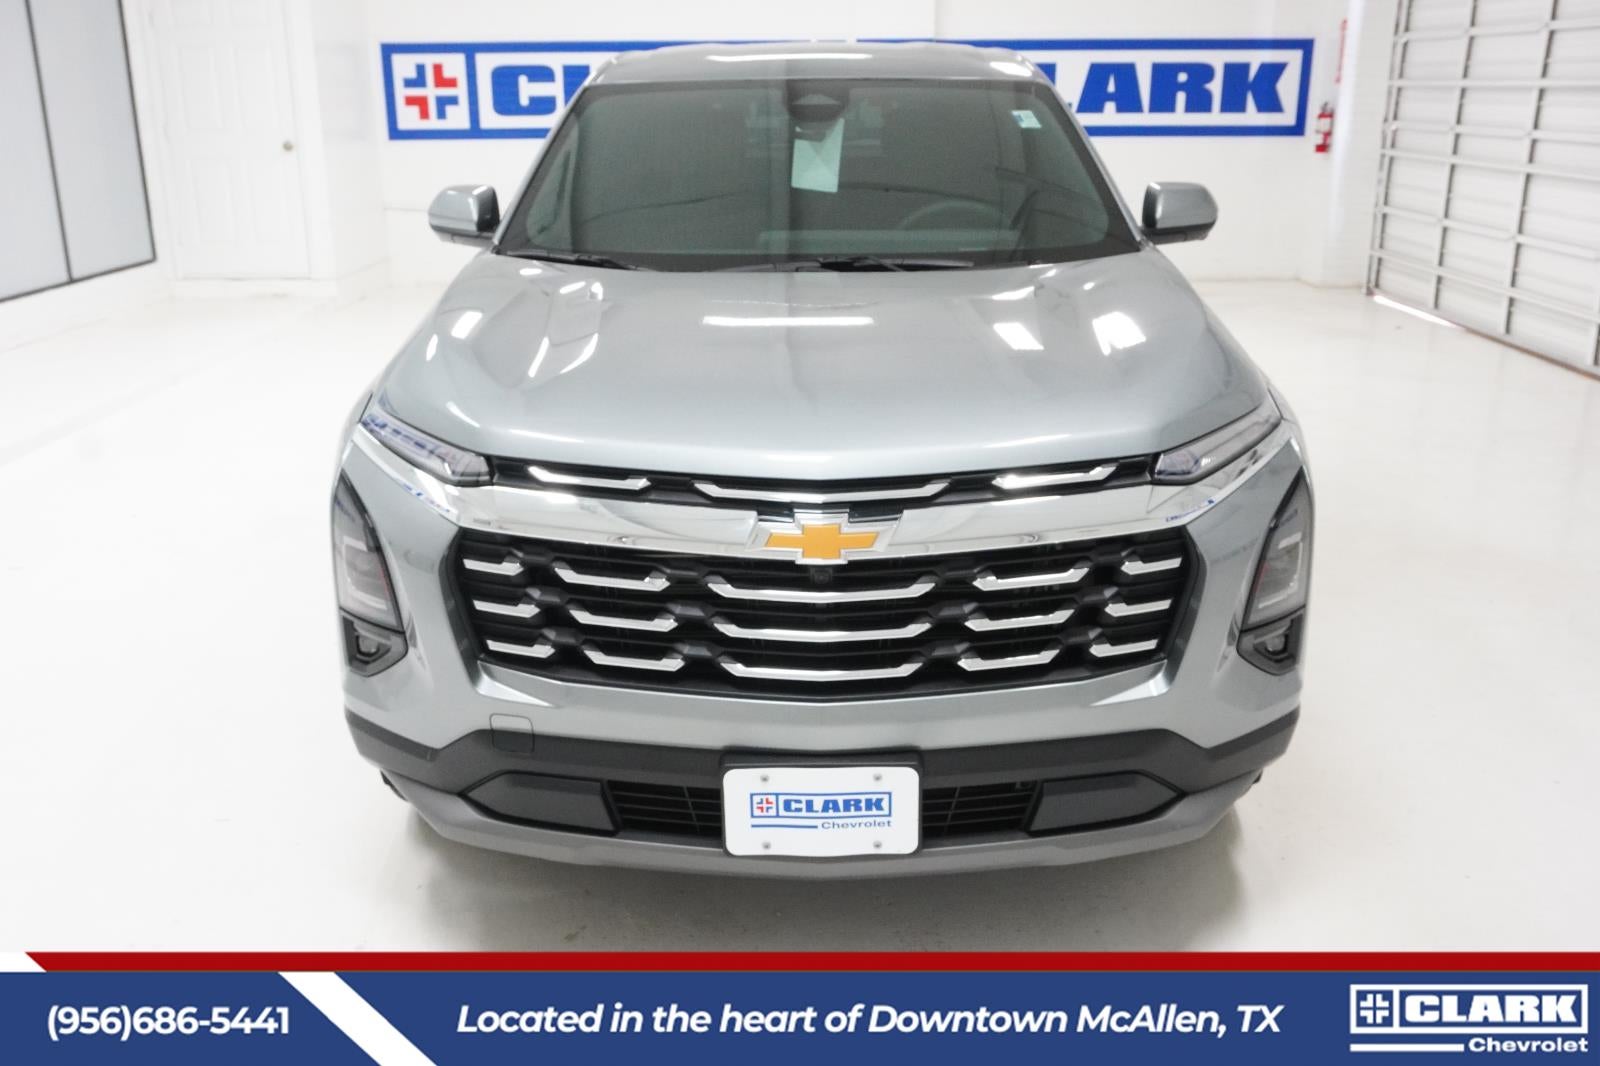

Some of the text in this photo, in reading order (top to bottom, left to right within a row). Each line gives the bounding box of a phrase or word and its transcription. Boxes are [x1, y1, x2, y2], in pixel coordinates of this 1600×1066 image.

[1036, 62, 1286, 114] ARK
[783, 798, 883, 812] CLARK
[822, 820, 892, 829] Chevrolet
